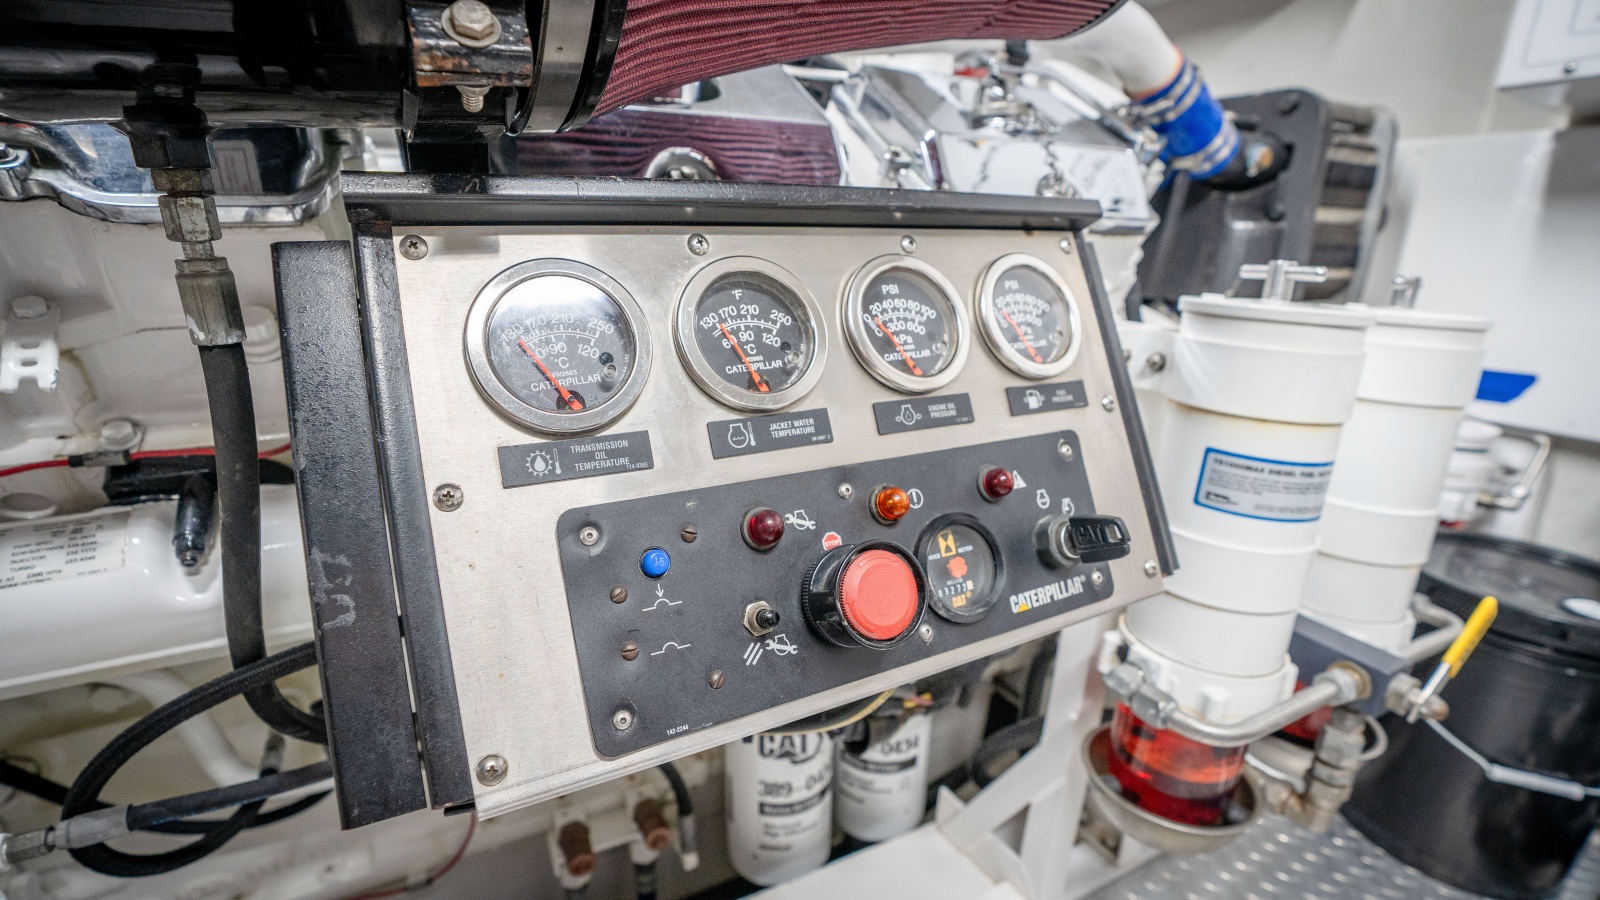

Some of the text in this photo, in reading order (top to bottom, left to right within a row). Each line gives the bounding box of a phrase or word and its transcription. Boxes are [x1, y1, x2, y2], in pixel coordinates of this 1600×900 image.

[882, 284, 899, 295] PSI
[869, 298, 936, 319] 20 40 60 80 100
[700, 304, 792, 330] 130 170 210 250
[500, 313, 614, 343] 130 170 210 250
[887, 321, 926, 335] 300 600
[739, 331, 754, 342] 90
[762, 333, 781, 347] 120
[894, 334, 913, 344] kPa
[549, 342, 566, 354] 90
[577, 344, 599, 358] 120
[928, 402, 956, 412] ENGINE OIL
[930, 409, 957, 418] PRESSURE
[769, 418, 815, 431] JACKET WATER
[771, 426, 816, 438] TEMPERATURE
[570, 440, 629, 454] TRANSMISSION
[594, 452, 608, 460] OIL
[574, 457, 630, 471] TEMPERATURE
[824, 539, 840, 548] STOP
[653, 557, 665, 567] 15
[759, 733, 807, 758] CAT
